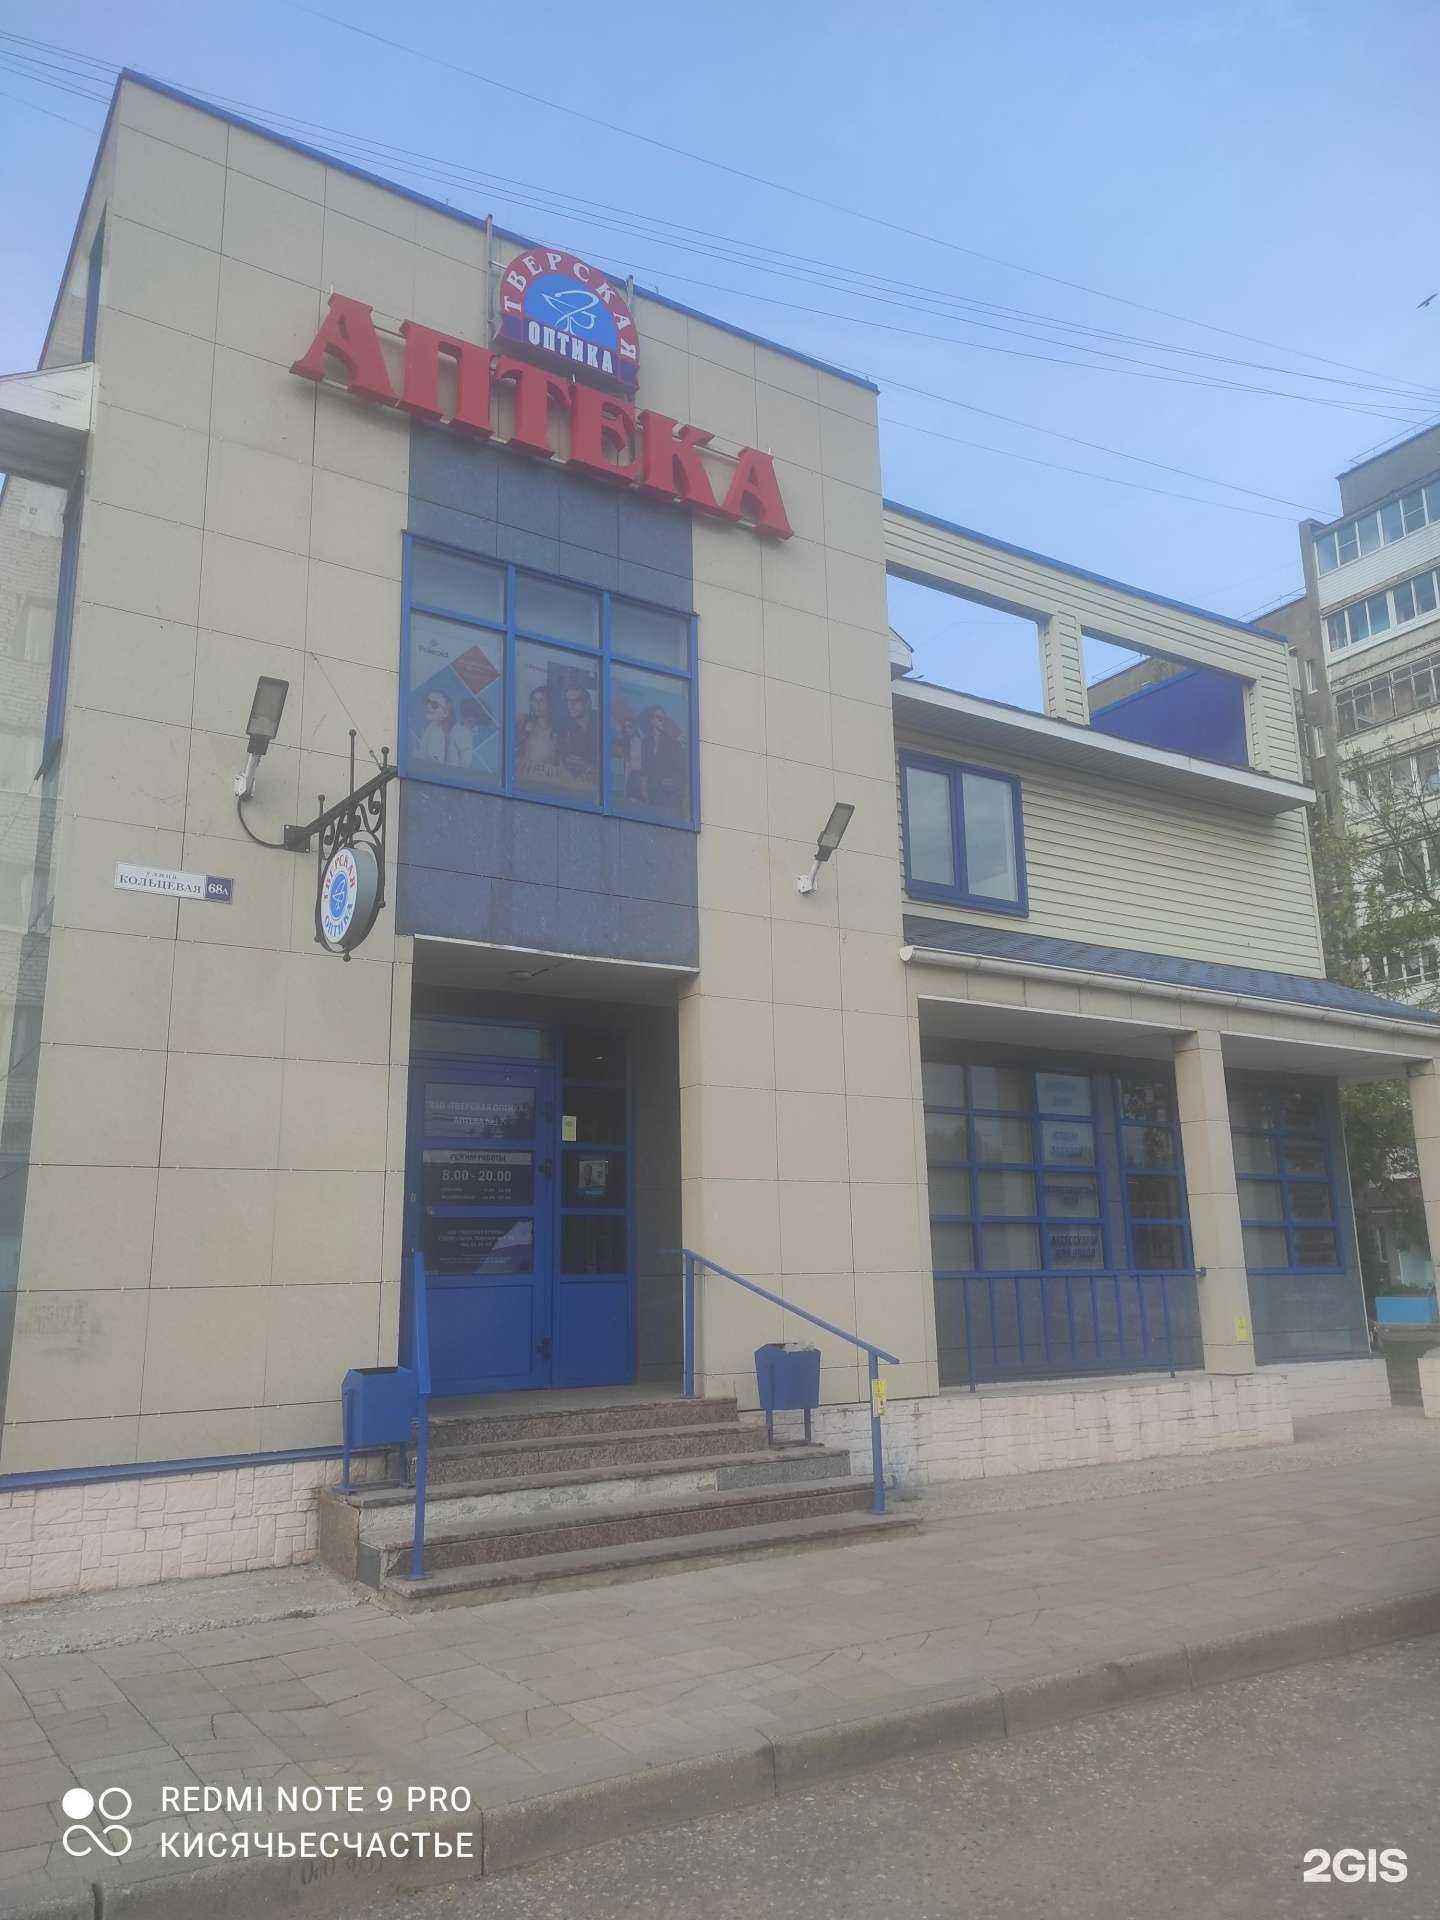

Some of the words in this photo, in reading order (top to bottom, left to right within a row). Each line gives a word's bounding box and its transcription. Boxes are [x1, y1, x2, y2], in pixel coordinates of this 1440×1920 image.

[504, 252, 637, 360] ТВЕРСКАЯ
[528, 320, 614, 375] ОПТИКА
[290, 292, 794, 541] АПТЕКА
[119, 873, 202, 895] КОЛЬЦЕВАЯ
[477, 1170, 512, 1183] 20.00
